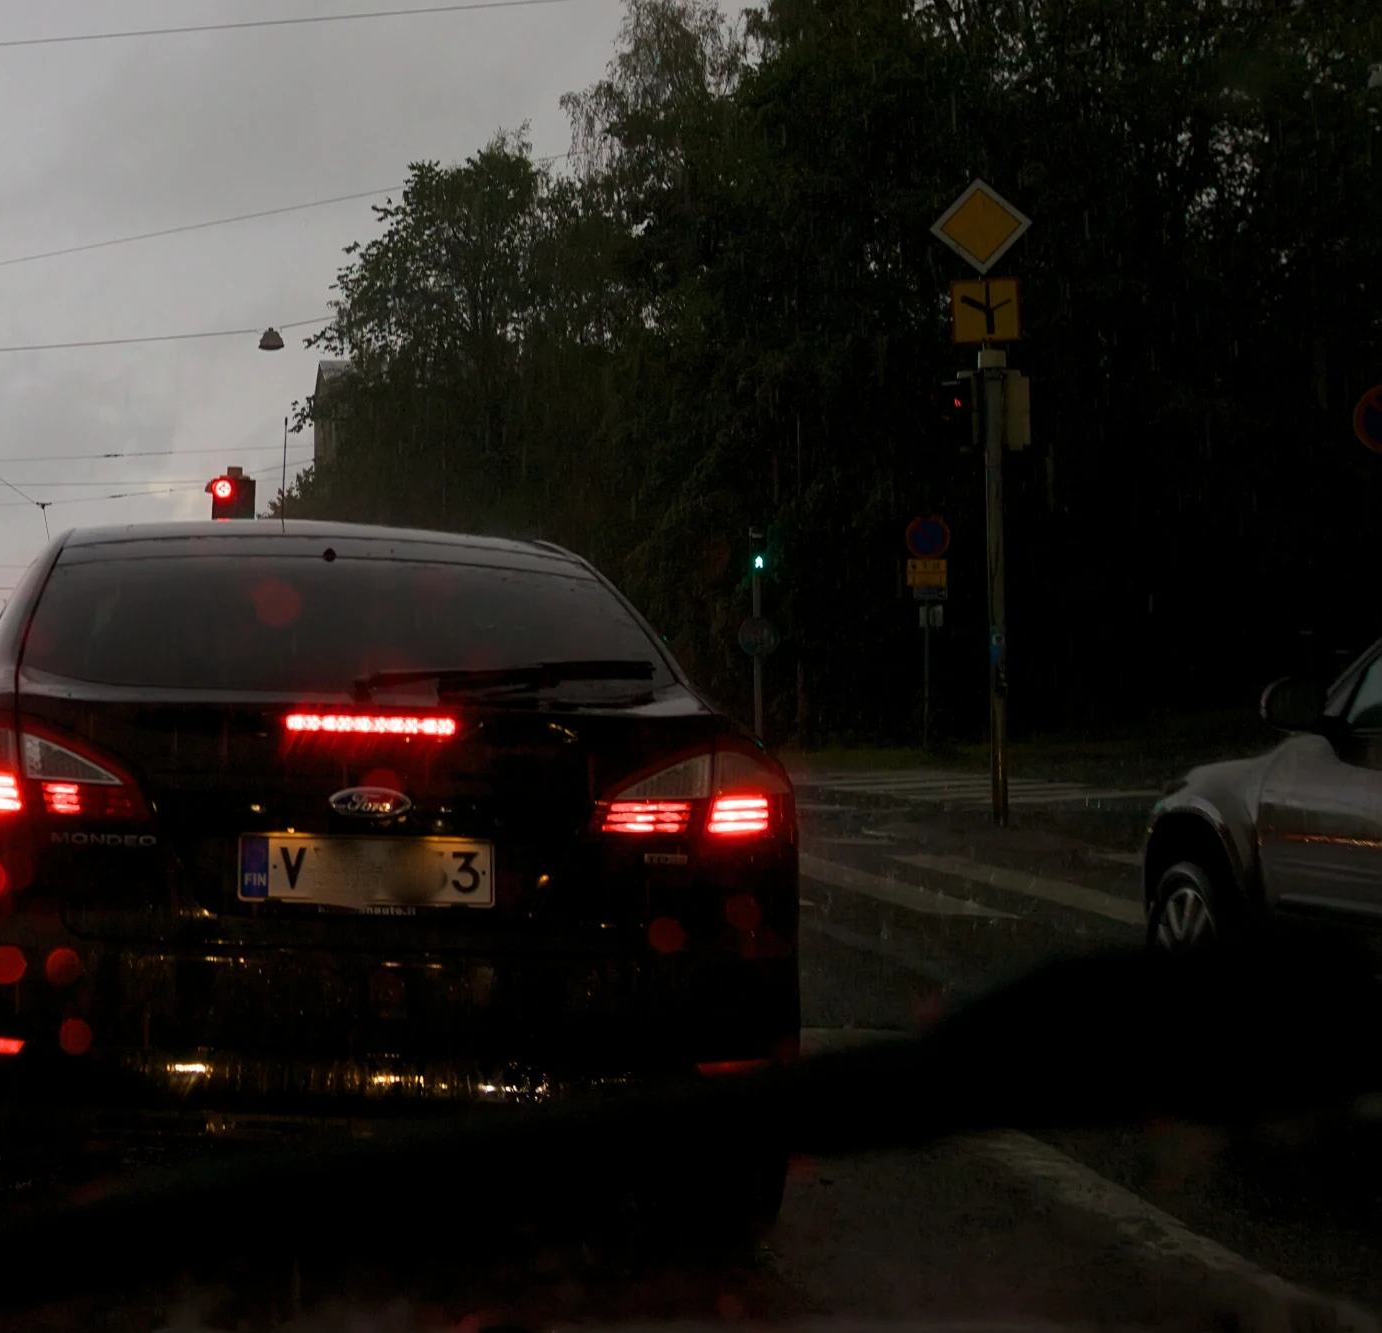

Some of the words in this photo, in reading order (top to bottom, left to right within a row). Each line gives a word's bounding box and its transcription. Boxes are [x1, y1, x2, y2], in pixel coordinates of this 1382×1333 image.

[346, 791, 394, 812] Ford
[50, 832, 158, 847] MONDEO
[244, 872, 267, 887] FIN
